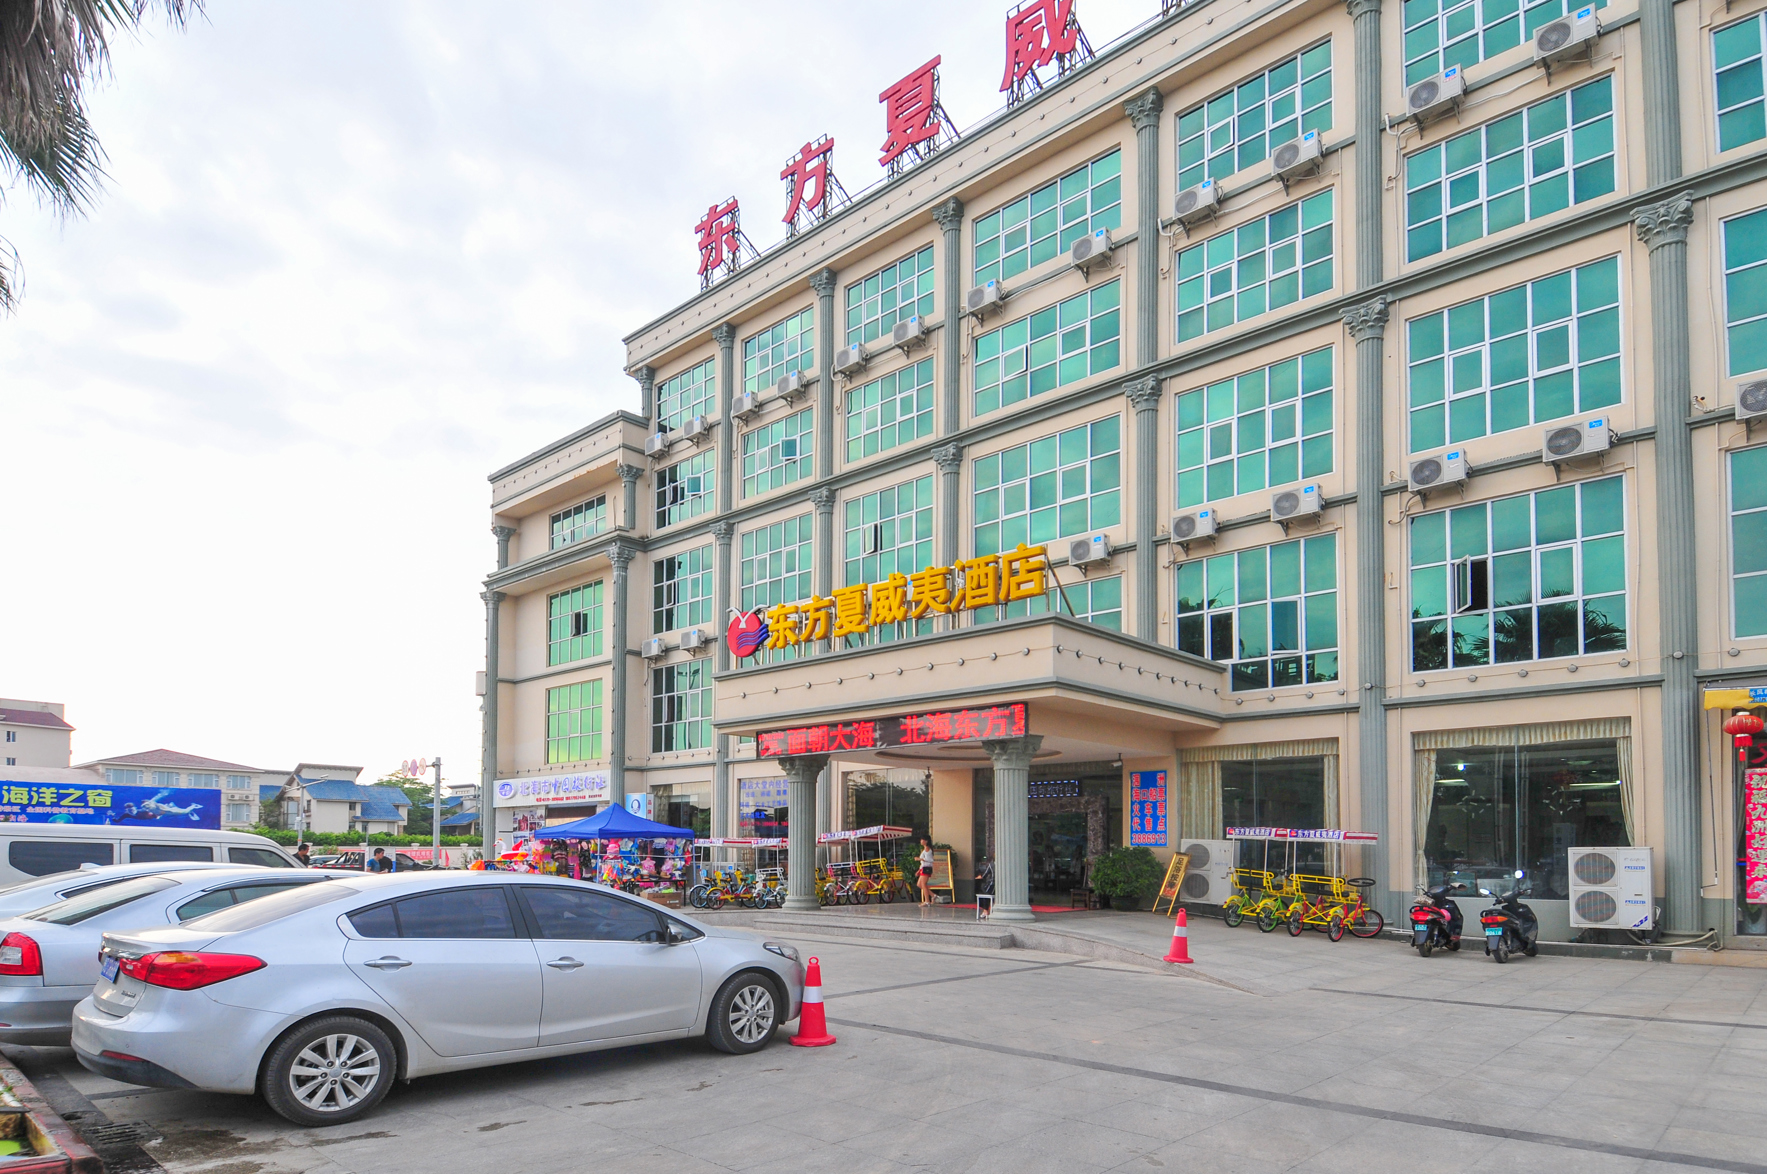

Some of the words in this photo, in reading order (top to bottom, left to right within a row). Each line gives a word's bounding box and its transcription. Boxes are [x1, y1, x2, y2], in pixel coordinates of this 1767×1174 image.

[767, 543, 1047, 651] 东方夏威夷酒店
[786, 720, 876, 755] 面朝大海
[2, 786, 113, 807] 海洋之窗
[1132, 802, 1166, 817] 火车票
[1132, 816, 1166, 831] 代售点
[1132, 832, 1166, 844] 3886913
[1297, 829, 1340, 840] 东方夏威夷酒店
